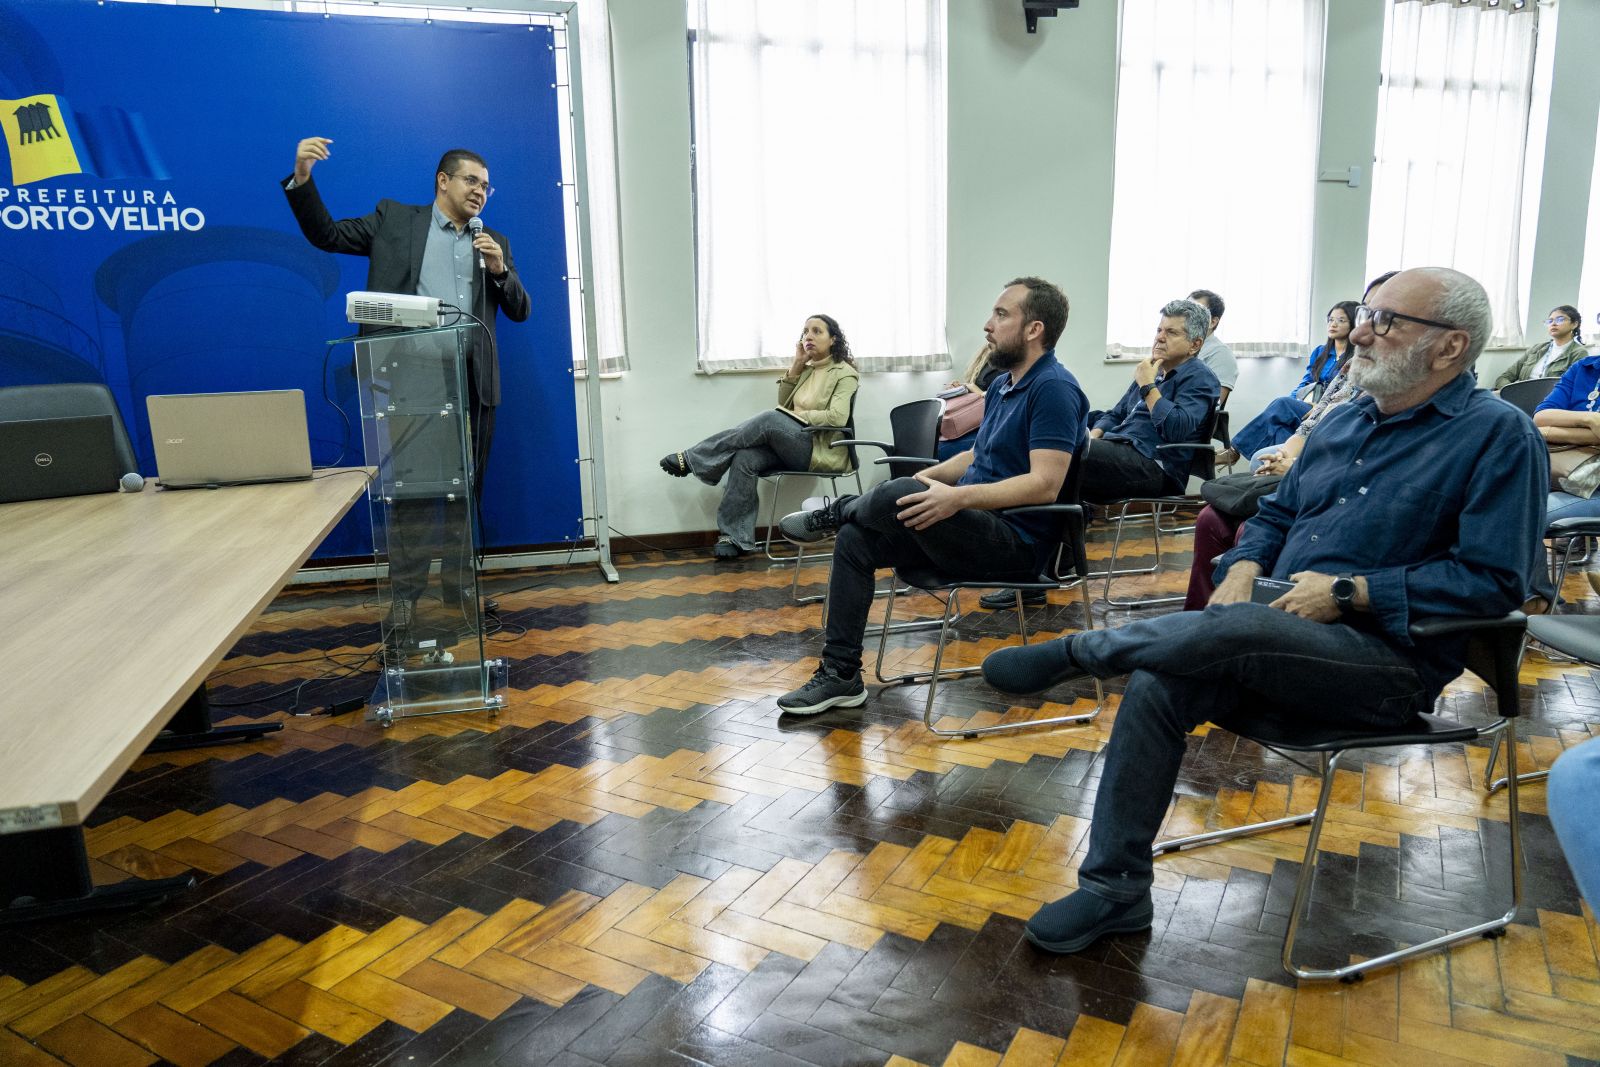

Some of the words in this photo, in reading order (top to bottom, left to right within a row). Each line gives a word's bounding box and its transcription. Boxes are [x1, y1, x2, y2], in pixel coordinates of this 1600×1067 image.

[0, 187, 177, 205] PREFEITURA
[0, 205, 95, 230] ORTO
[97, 206, 206, 232] VELHO
